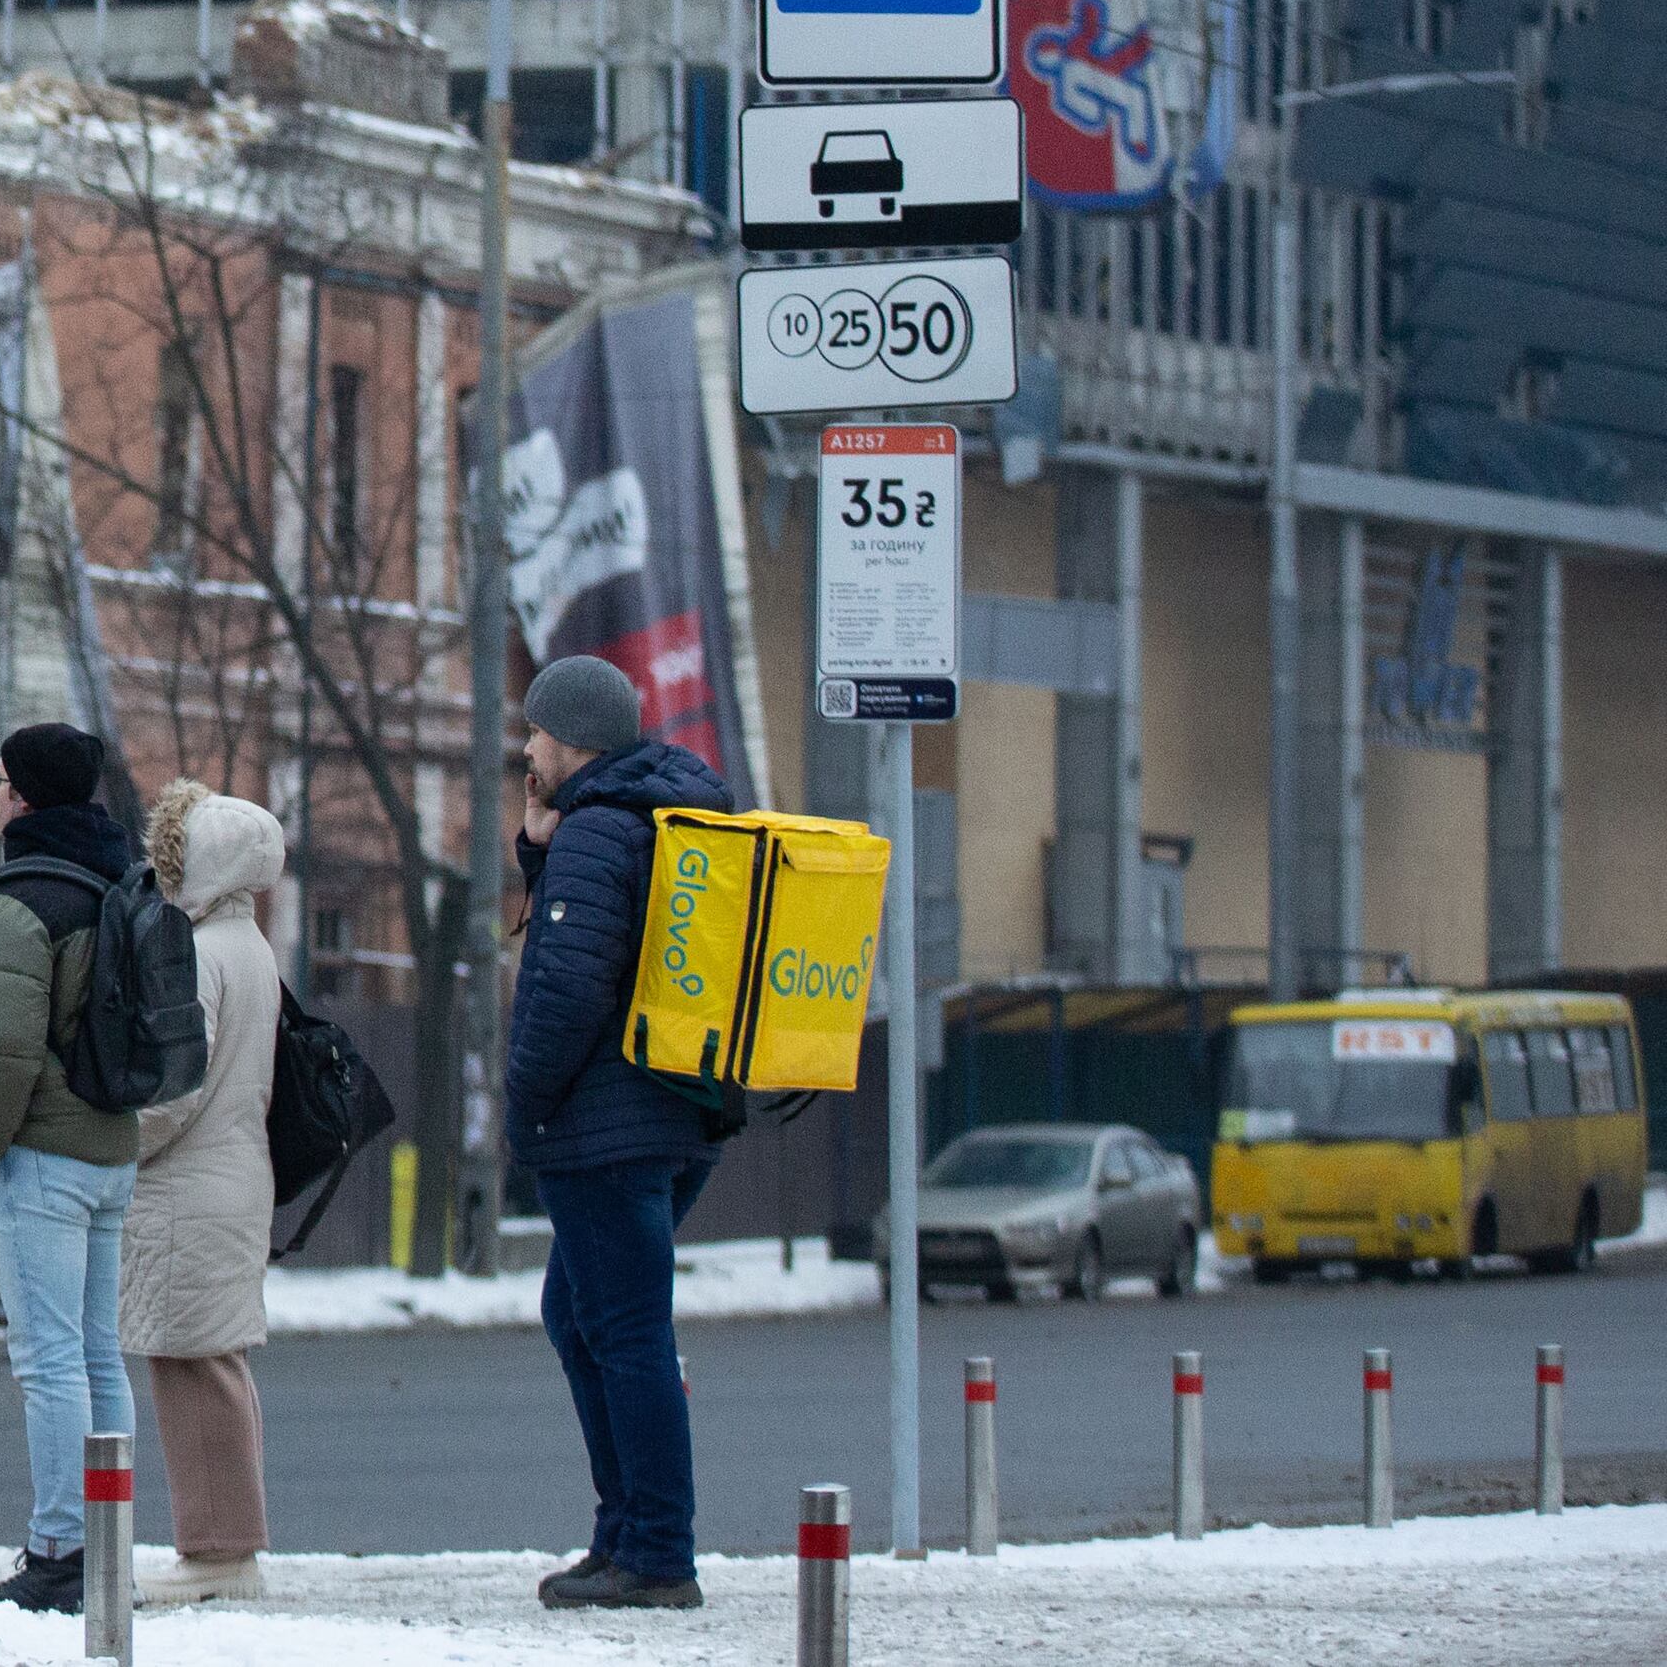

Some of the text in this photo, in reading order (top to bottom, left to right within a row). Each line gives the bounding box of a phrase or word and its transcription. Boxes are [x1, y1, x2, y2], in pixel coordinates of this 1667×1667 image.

[783, 301, 955, 356] 10 25 50
[830, 433, 885, 450] A1257
[841, 478, 907, 528] 35
[850, 539, 926, 554] за годину
[664, 848, 709, 972] Glovo
[769, 947, 859, 1002] Glovo
